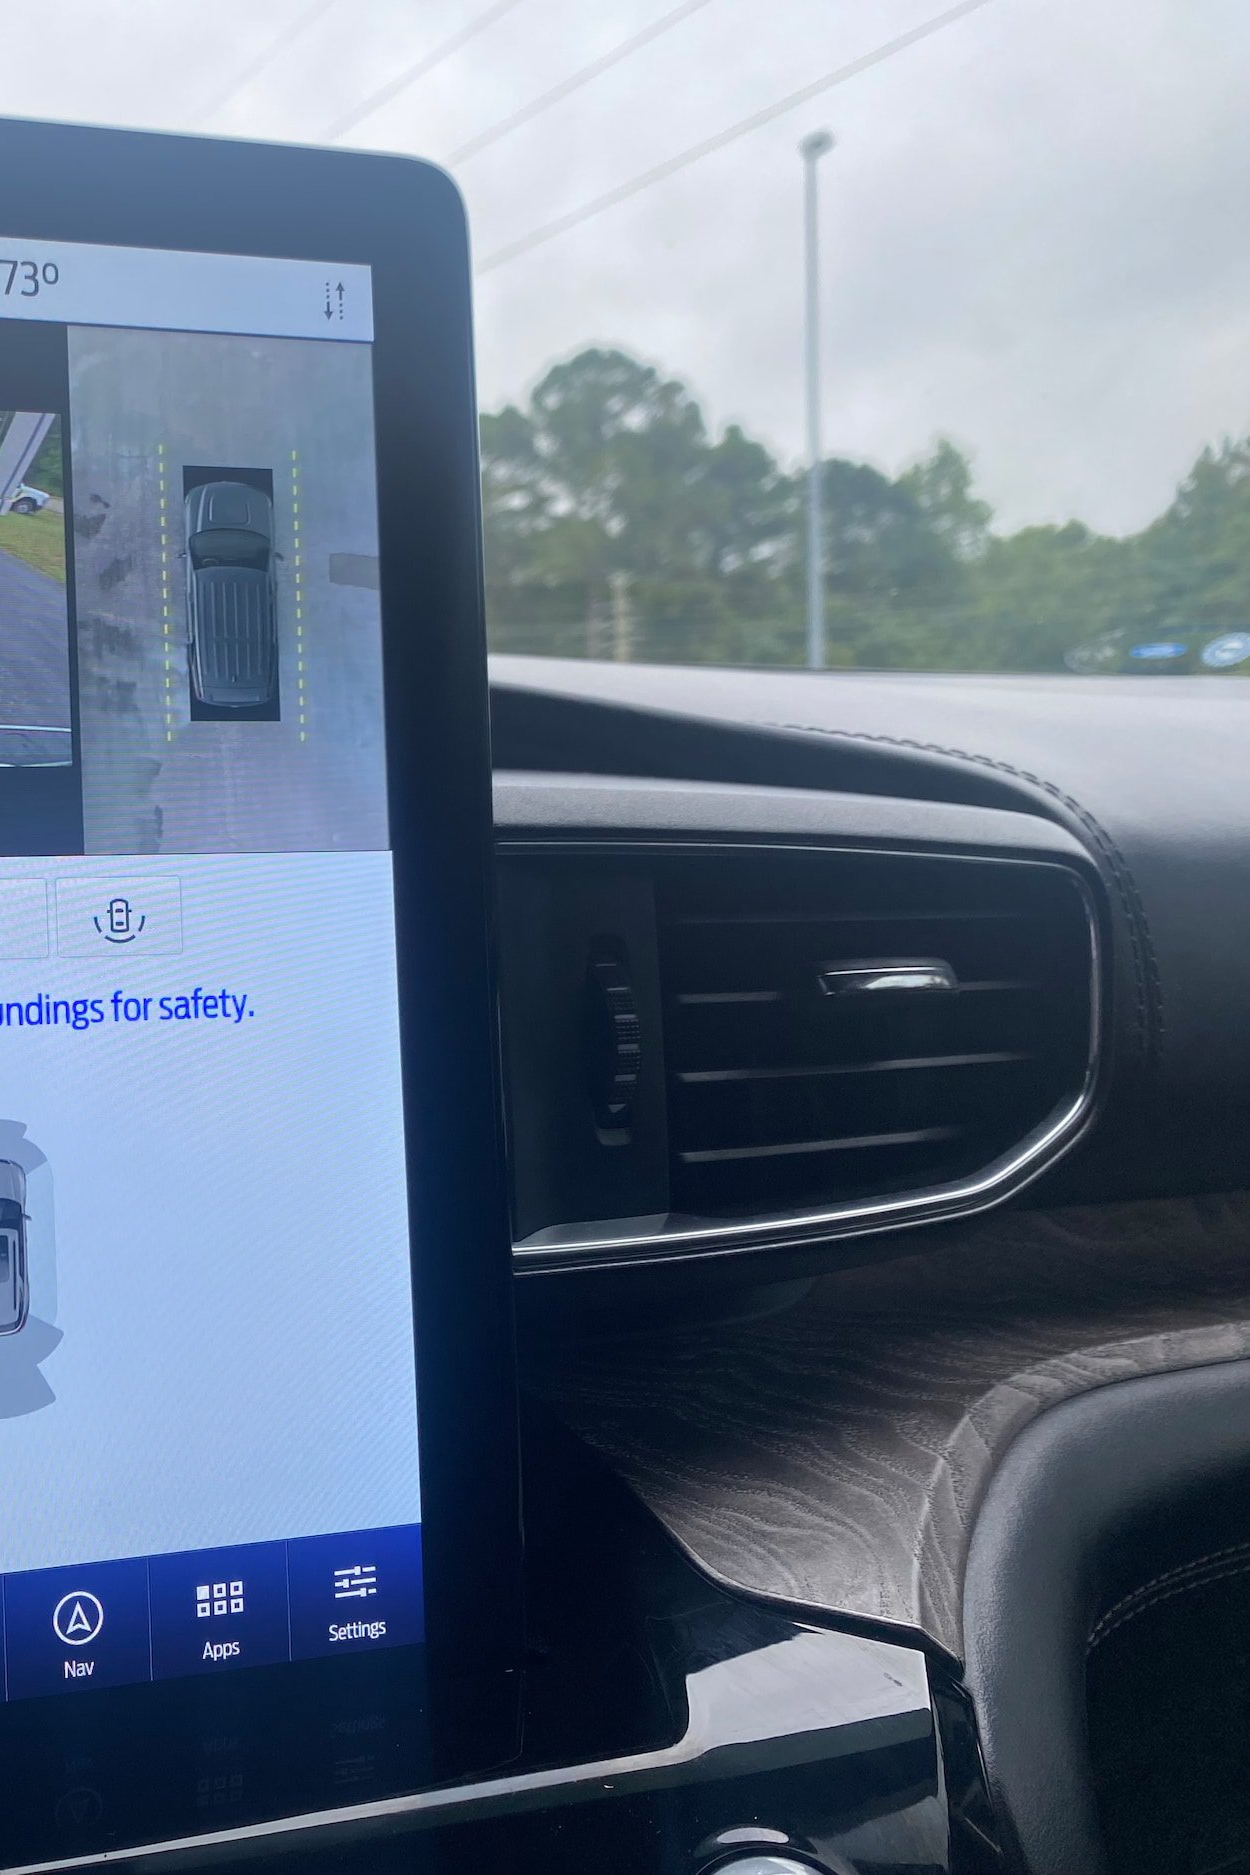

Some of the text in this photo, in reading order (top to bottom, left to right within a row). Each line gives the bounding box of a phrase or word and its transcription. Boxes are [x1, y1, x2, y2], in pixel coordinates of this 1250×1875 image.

[111, 990, 153, 1022] for
[159, 987, 256, 1022] safety.
[328, 1619, 387, 1643] Settings
[202, 1640, 241, 1661] Apps
[64, 1658, 95, 1680] Nav
